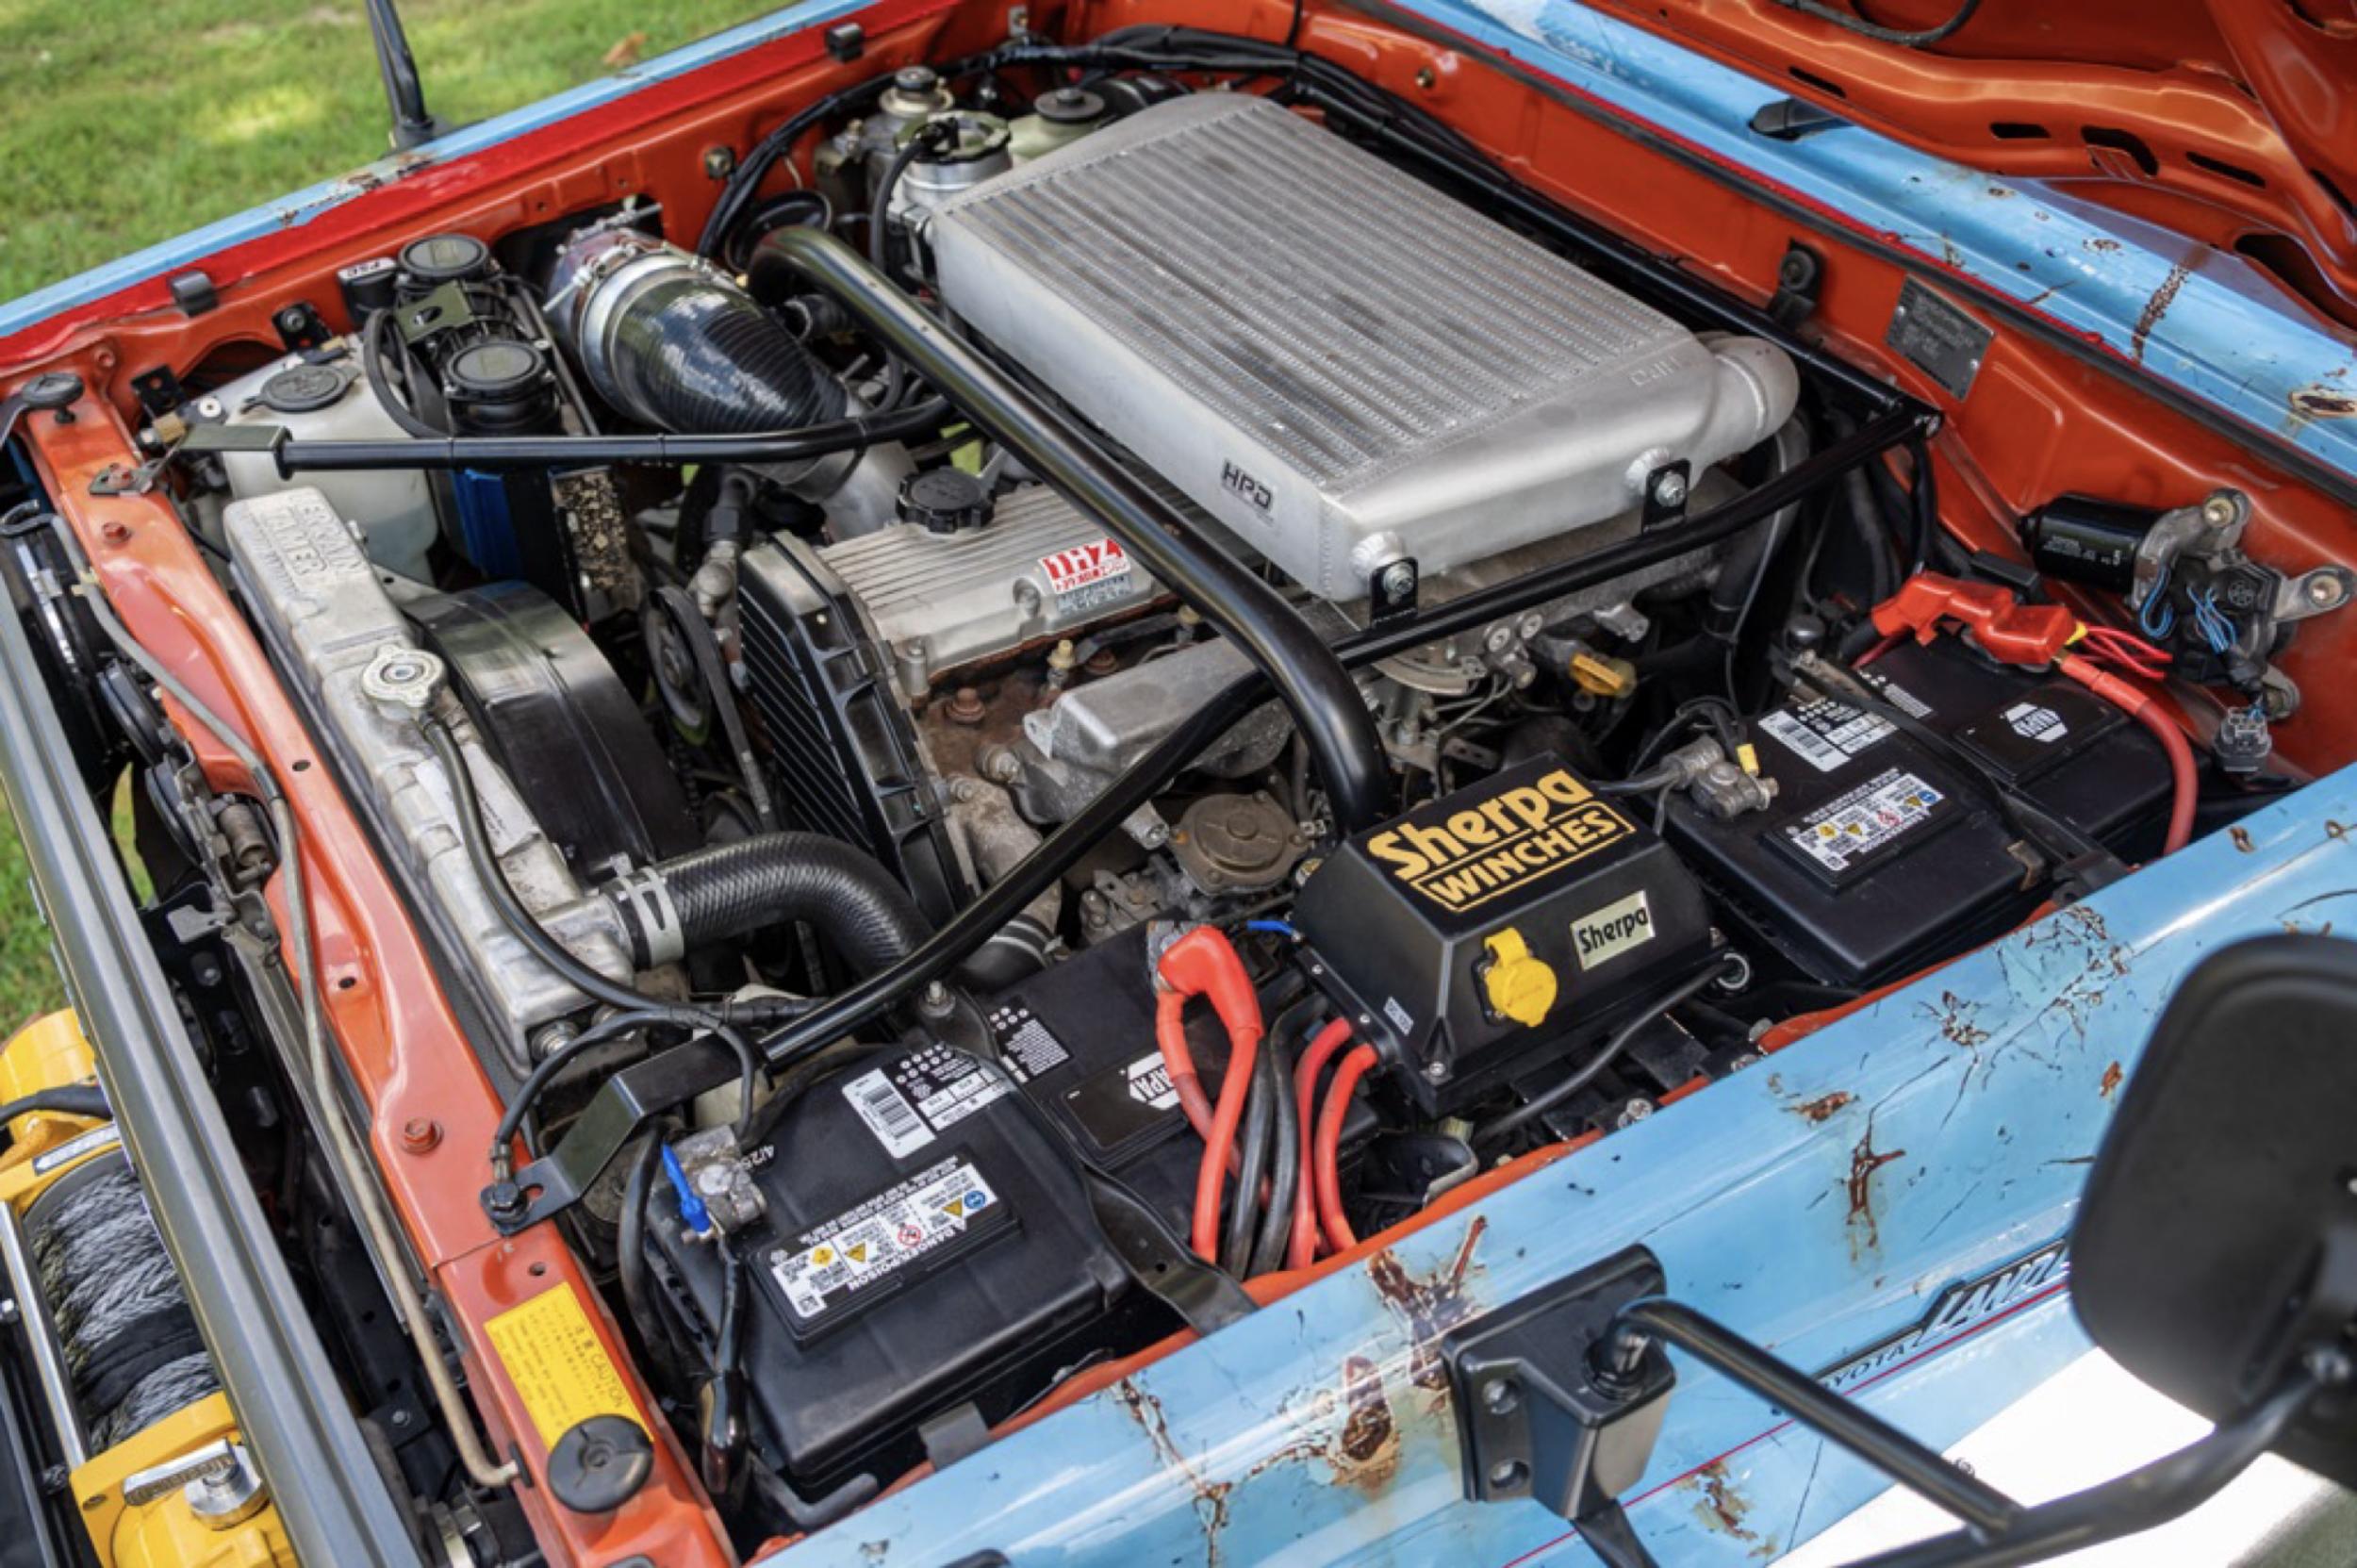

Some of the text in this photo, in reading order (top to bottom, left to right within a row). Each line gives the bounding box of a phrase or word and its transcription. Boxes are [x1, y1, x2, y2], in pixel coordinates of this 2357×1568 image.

[1222, 459, 1272, 510] HPD
[1041, 538, 1125, 581] 1HZ
[1368, 768, 1593, 881] Sherpa
[1427, 809, 1618, 904] WINCHES
[1578, 906, 1650, 955] Sherpa
[1130, 1063, 1176, 1103] APA
[589, 1352, 626, 1407] CAUTION
[1821, 1341, 1905, 1390] YOTA
